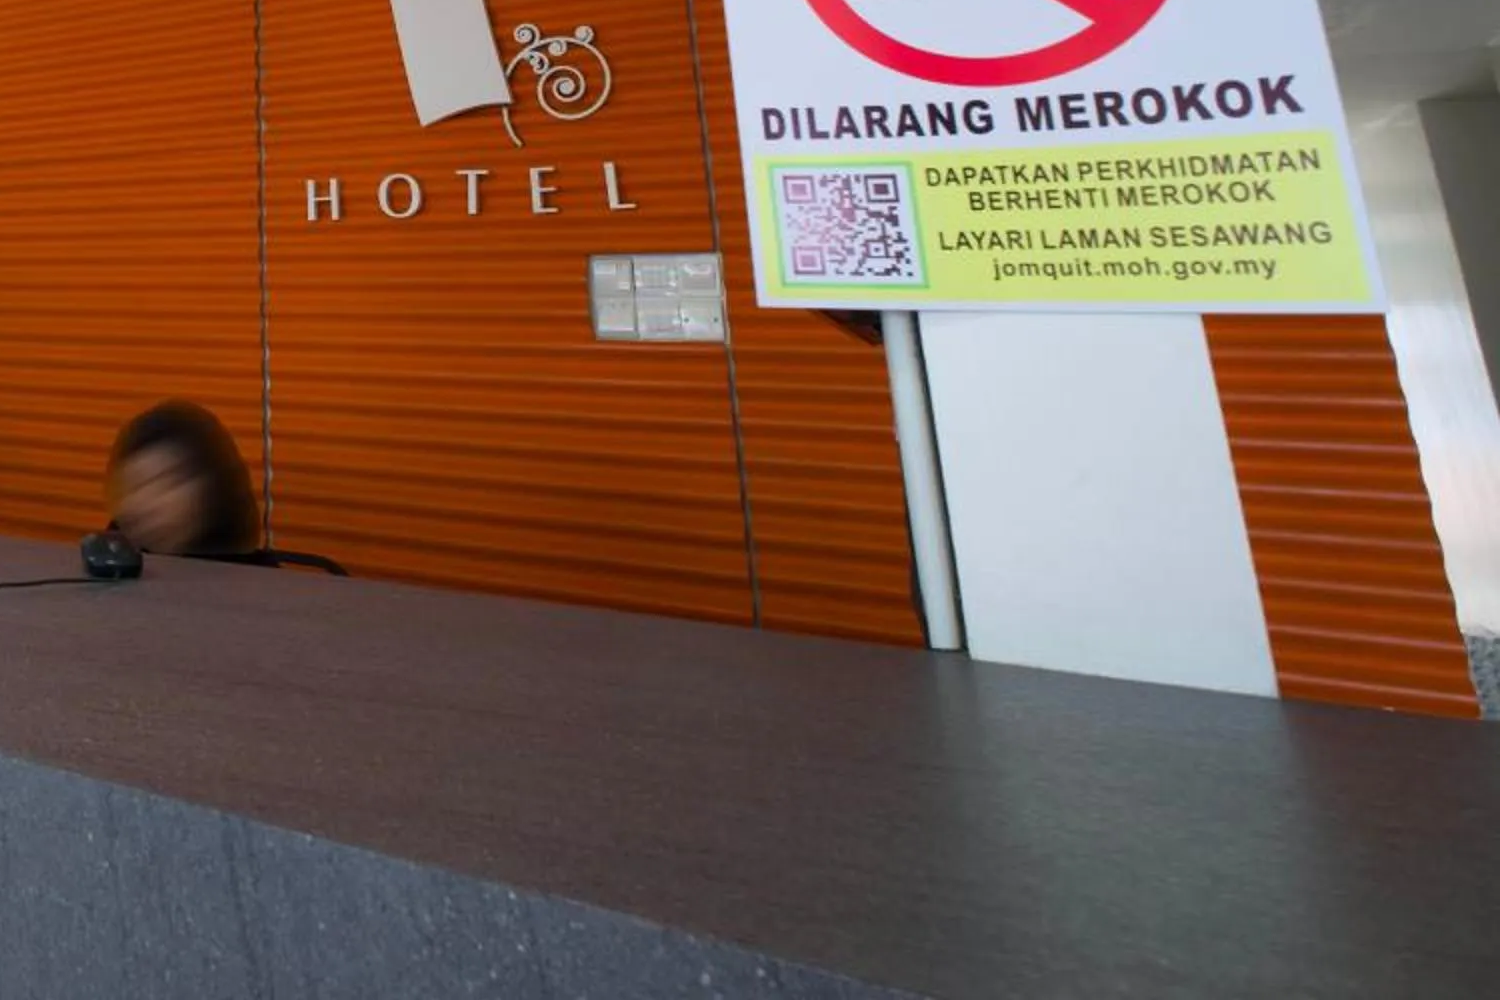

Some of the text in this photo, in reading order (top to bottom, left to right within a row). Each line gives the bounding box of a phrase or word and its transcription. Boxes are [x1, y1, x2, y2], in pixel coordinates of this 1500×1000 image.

[762, 75, 1303, 140] DILARANG MEROKOK
[925, 149, 1321, 187] DAPATKAN PERKHIDMATAN
[306, 162, 636, 221] HOTEL
[968, 180, 1276, 212] BERHENTI MEROKOK
[939, 221, 1332, 251] LAYARI LAMAN SESAWANG
[993, 257, 1276, 281] jomquit.moh.gov.my
